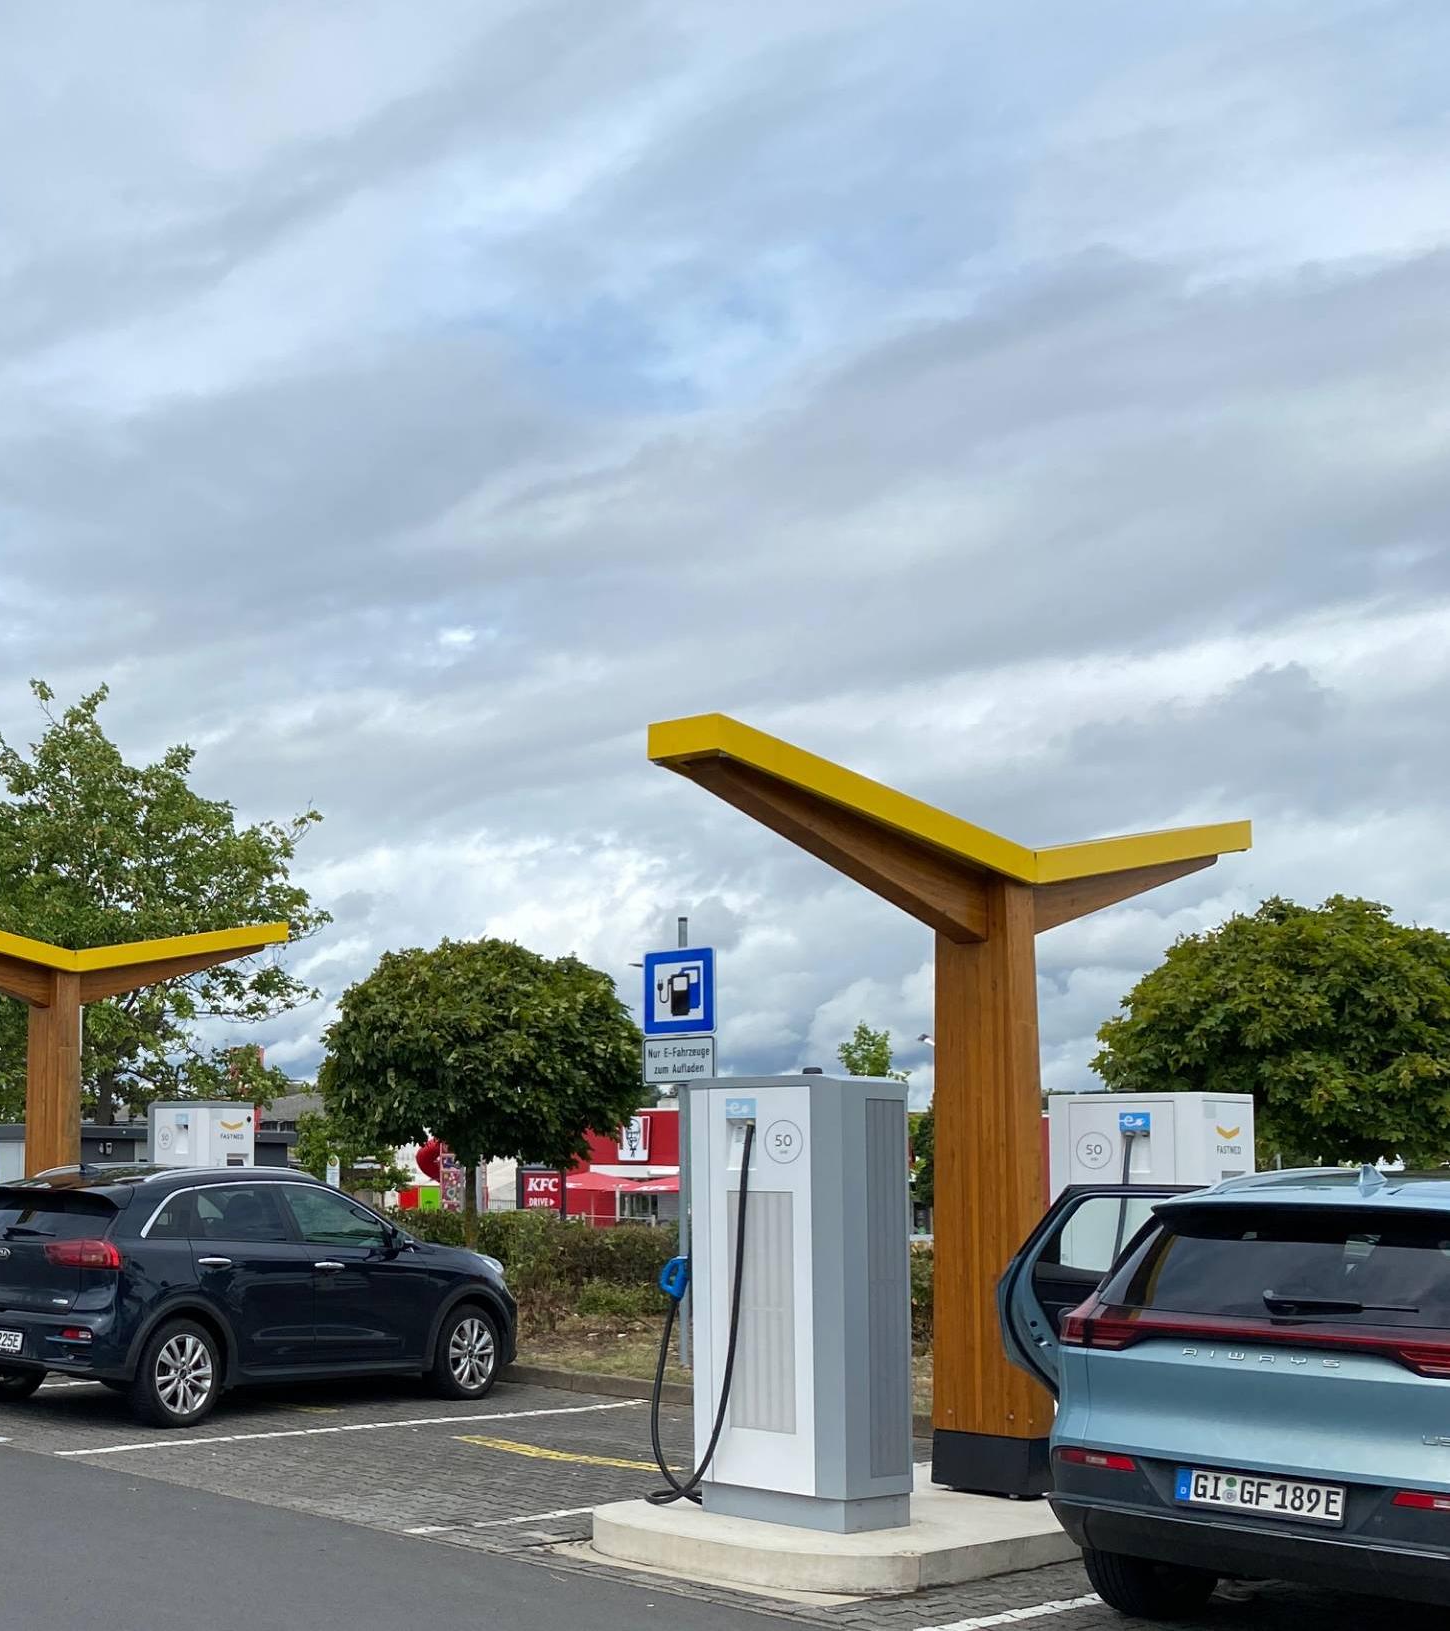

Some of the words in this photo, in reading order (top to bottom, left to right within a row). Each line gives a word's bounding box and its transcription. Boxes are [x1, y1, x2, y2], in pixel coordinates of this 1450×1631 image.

[648, 1048, 660, 1058] Nur
[663, 1047, 710, 1059] E-Fahrzeuge
[654, 1066, 669, 1074] zum
[672, 1062, 704, 1073] Aufladen
[775, 1134, 793, 1147] 50
[1085, 1144, 1103, 1155] 50
[1216, 1145, 1242, 1155] FASTNED
[527, 1178, 558, 1192] KFC
[528, 1197, 548, 1207] DRIVE
[1181, 1347, 1341, 1369] AIWAYS
[1193, 1474, 1221, 1501] GI
[1239, 1480, 1272, 1506] GF
